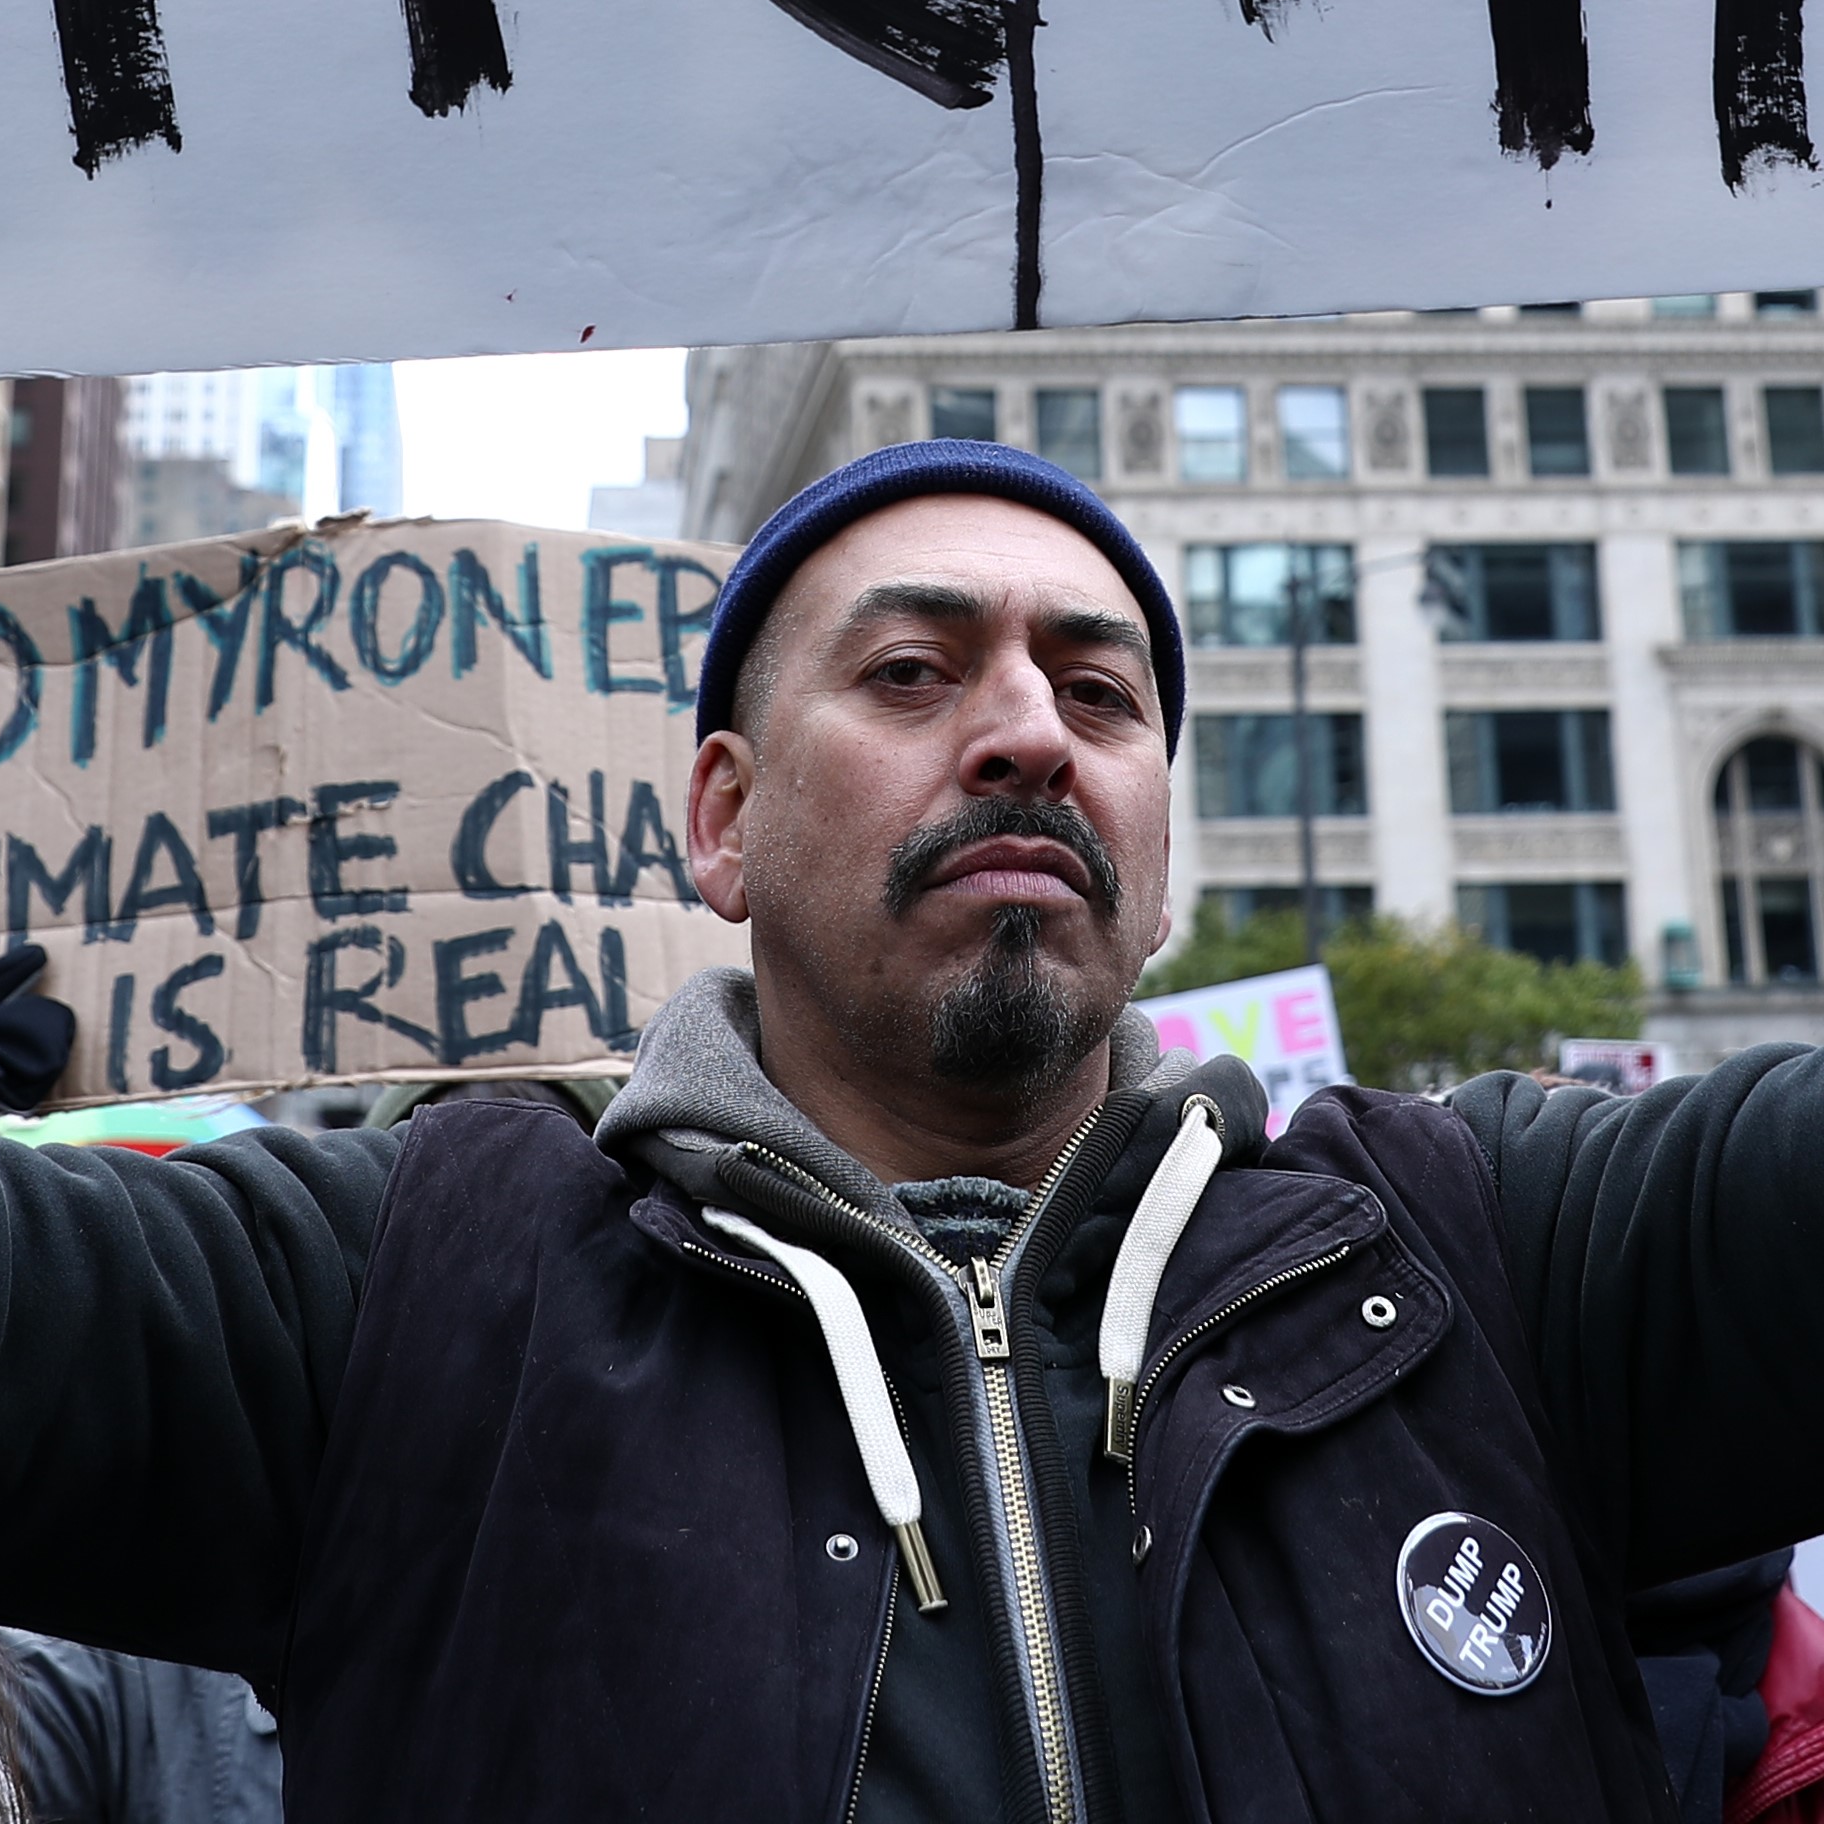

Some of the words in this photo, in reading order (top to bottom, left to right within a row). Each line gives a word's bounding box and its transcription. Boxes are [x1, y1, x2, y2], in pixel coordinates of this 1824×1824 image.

[69, 539, 554, 769] MYRON
[107, 954, 232, 1094] IS
[302, 917, 642, 1075] REAL
[1426, 1536, 1484, 1632] DUMP
[1459, 1562, 1525, 1671] TRUMP
